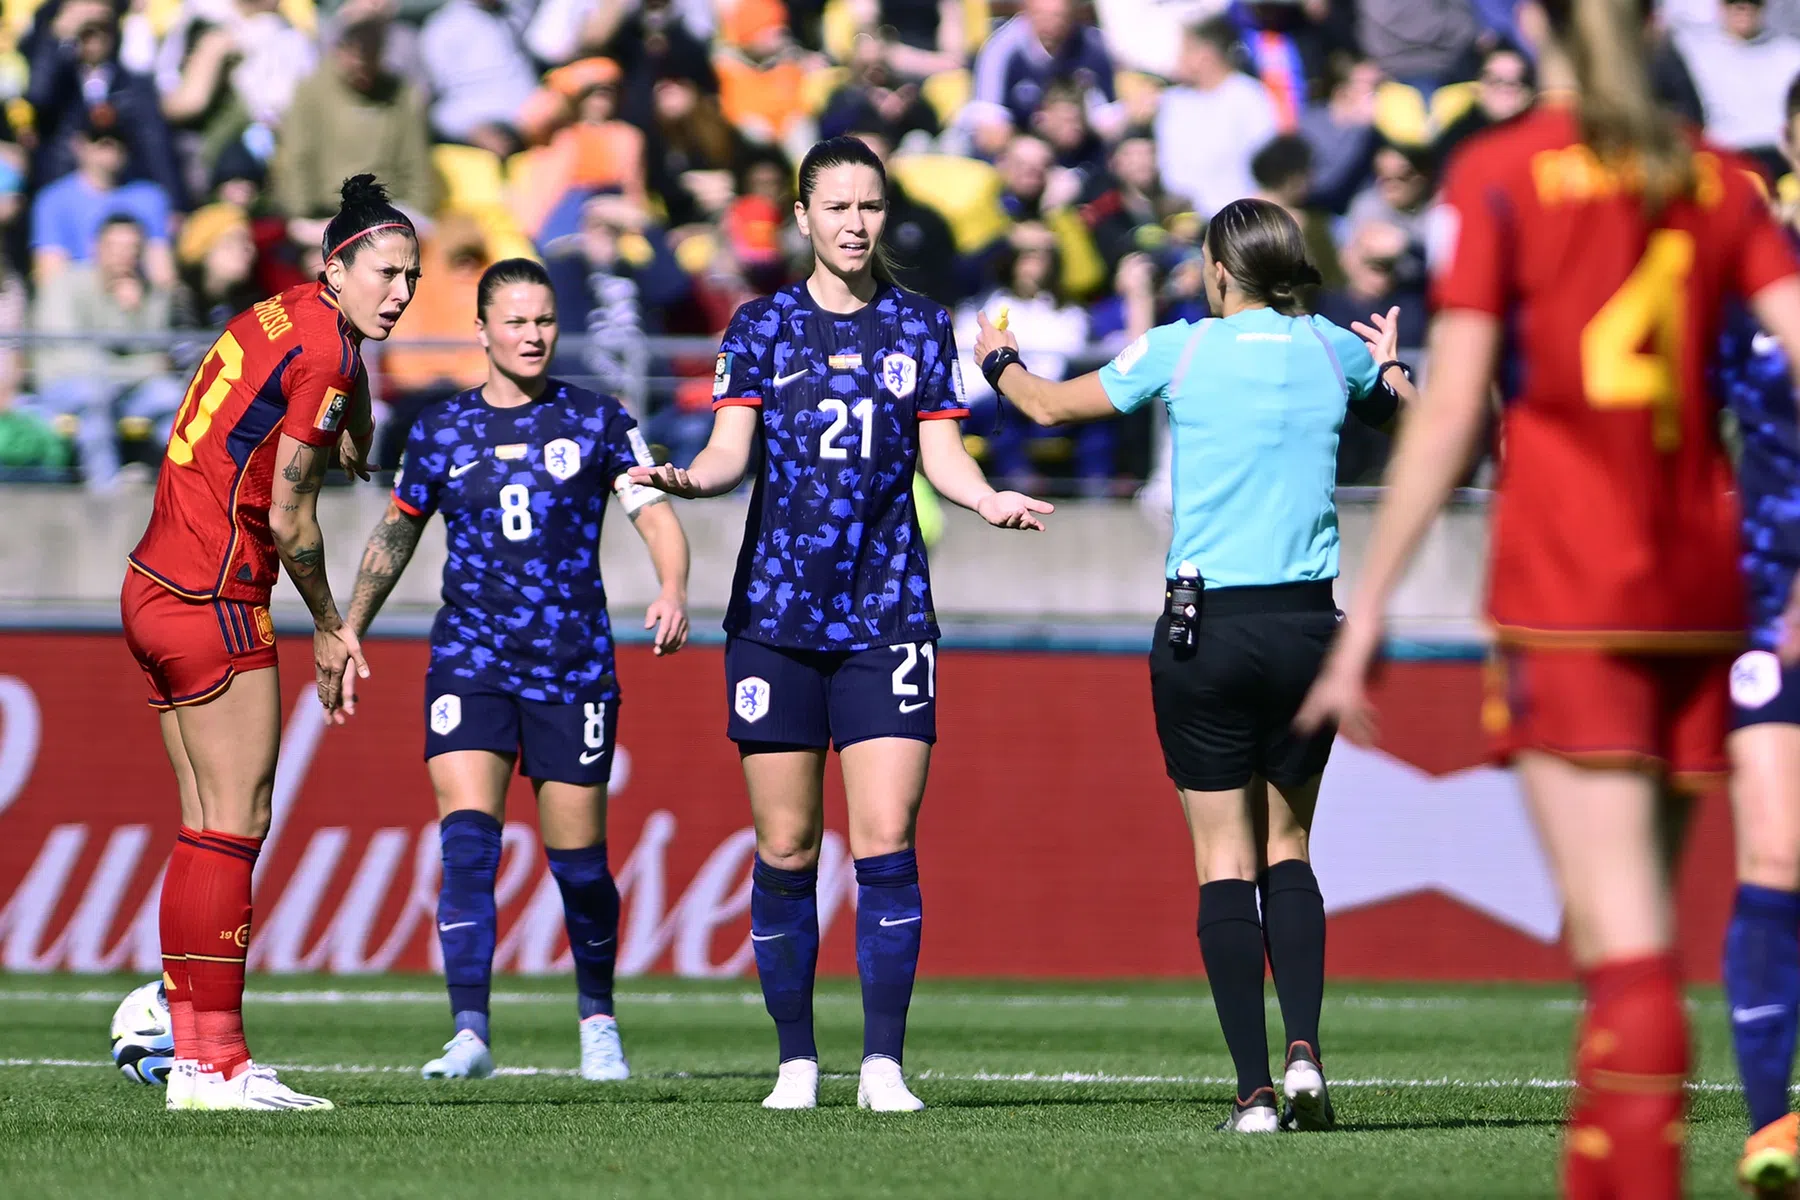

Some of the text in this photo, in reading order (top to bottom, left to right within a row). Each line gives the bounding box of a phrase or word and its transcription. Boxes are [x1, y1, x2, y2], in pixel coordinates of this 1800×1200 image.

[1580, 228, 1697, 452] 4
[817, 397, 874, 460] 21
[499, 484, 532, 542] 8
[889, 641, 934, 698] 21
[584, 702, 606, 749] 8
[219, 930, 233, 940] 19
